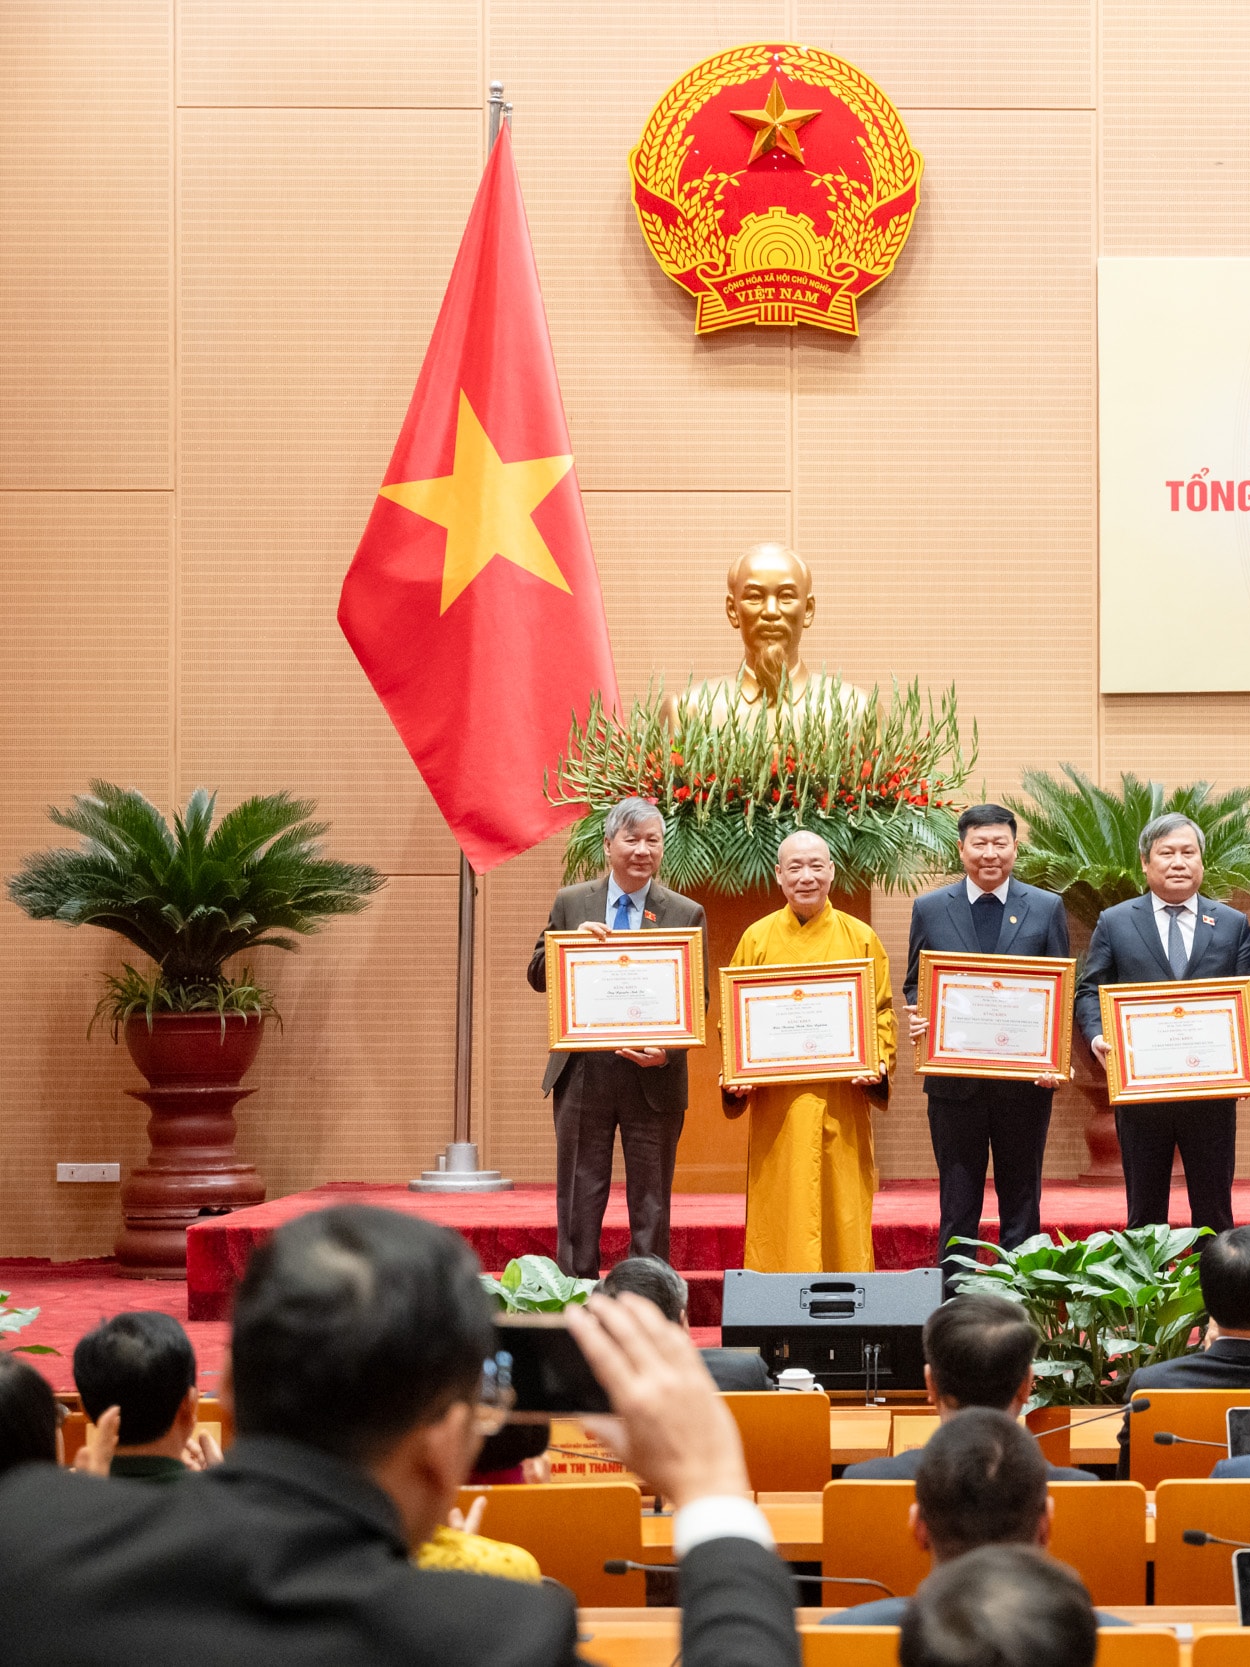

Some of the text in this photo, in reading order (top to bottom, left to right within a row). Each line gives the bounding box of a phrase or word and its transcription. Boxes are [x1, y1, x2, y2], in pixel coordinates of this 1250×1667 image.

[723, 273, 832, 295] CỘNG HÒA XÃ HỘI CHỦ NGHĨA
[735, 285, 819, 304] VIỆT NAM
[570, 1463, 586, 1476] THỊ
[589, 1462, 623, 1473] THANH
